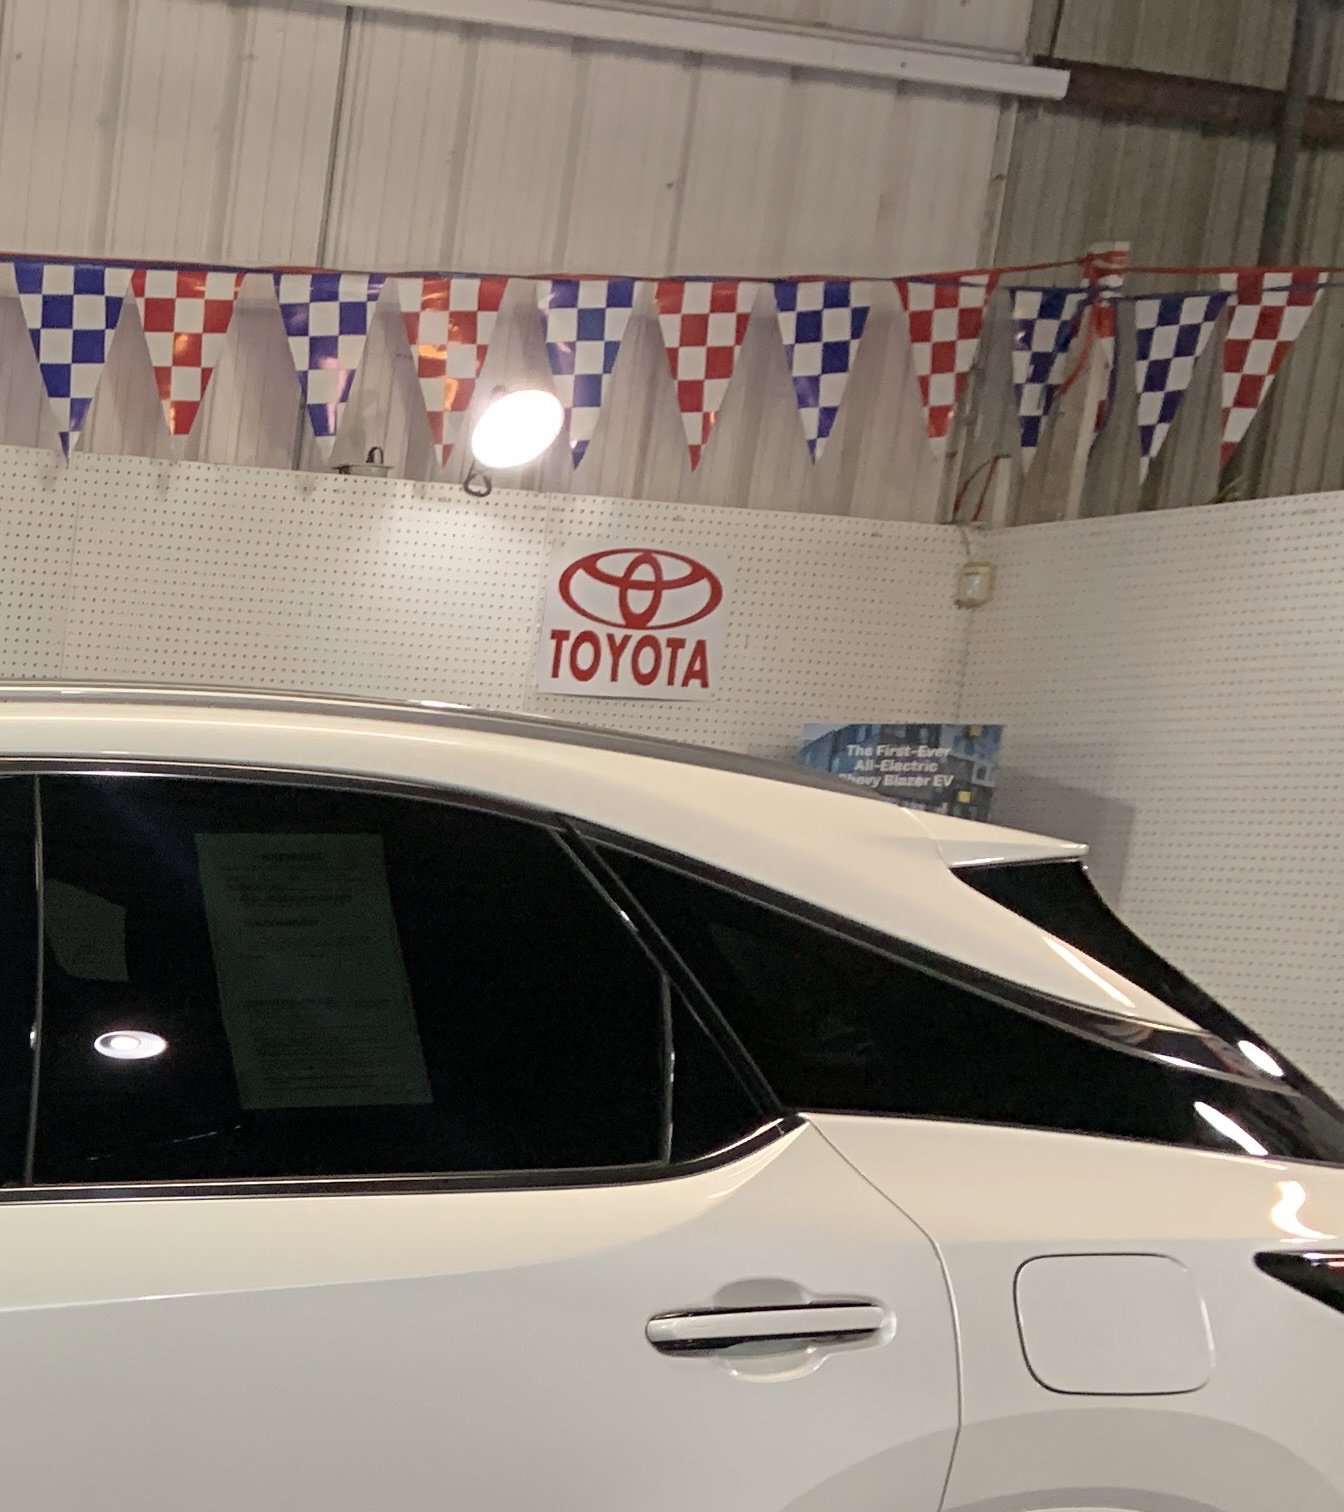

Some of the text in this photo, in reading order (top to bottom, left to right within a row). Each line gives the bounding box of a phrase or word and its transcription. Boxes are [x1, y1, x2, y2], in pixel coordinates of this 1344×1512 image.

[550, 629, 710, 689] TOYOTA
[847, 744, 951, 757] The First-Ever
[854, 759, 939, 772] All-Electric
[883, 774, 930, 787] Blazer
[932, 774, 954, 787] EV
